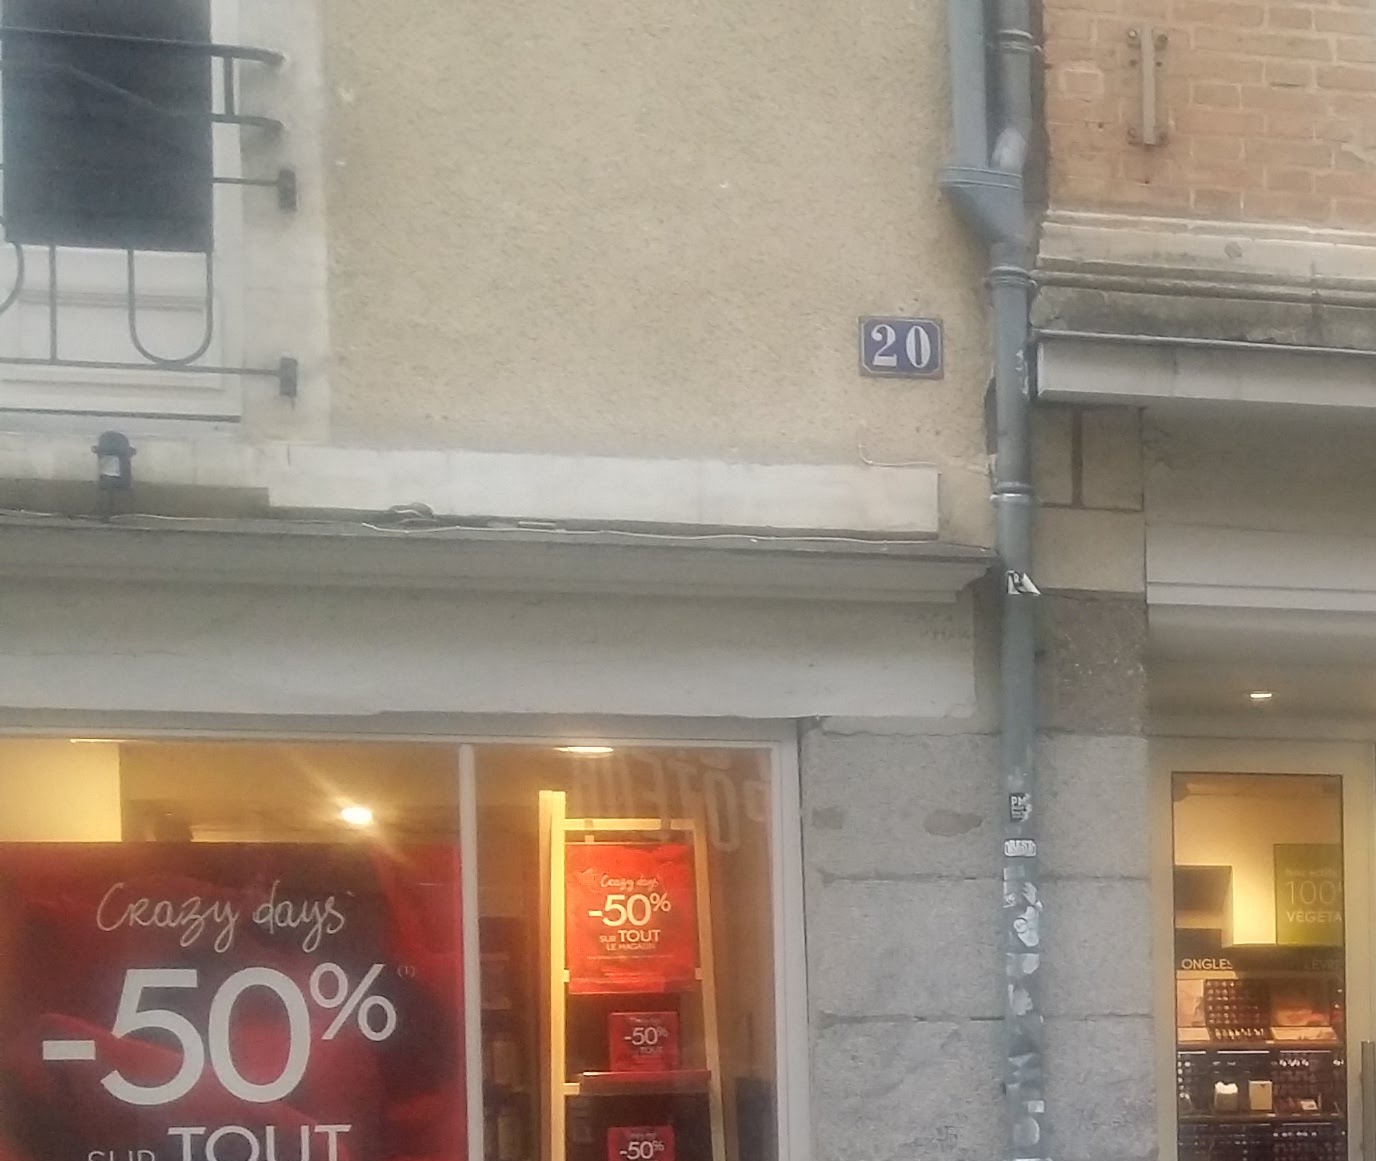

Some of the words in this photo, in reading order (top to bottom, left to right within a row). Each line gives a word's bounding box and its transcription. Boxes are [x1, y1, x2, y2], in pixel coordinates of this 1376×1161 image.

[871, 324, 931, 368] 20
[96, 882, 239, 953] Crazy
[588, 893, 671, 926] -50%
[600, 935, 616, 943] SUR
[618, 929, 661, 942] TOUT
[607, 943, 617, 951] LE
[42, 962, 397, 1105] -50%
[624, 1026, 668, 1046] -50%
[619, 1140, 665, 1160] -50%
